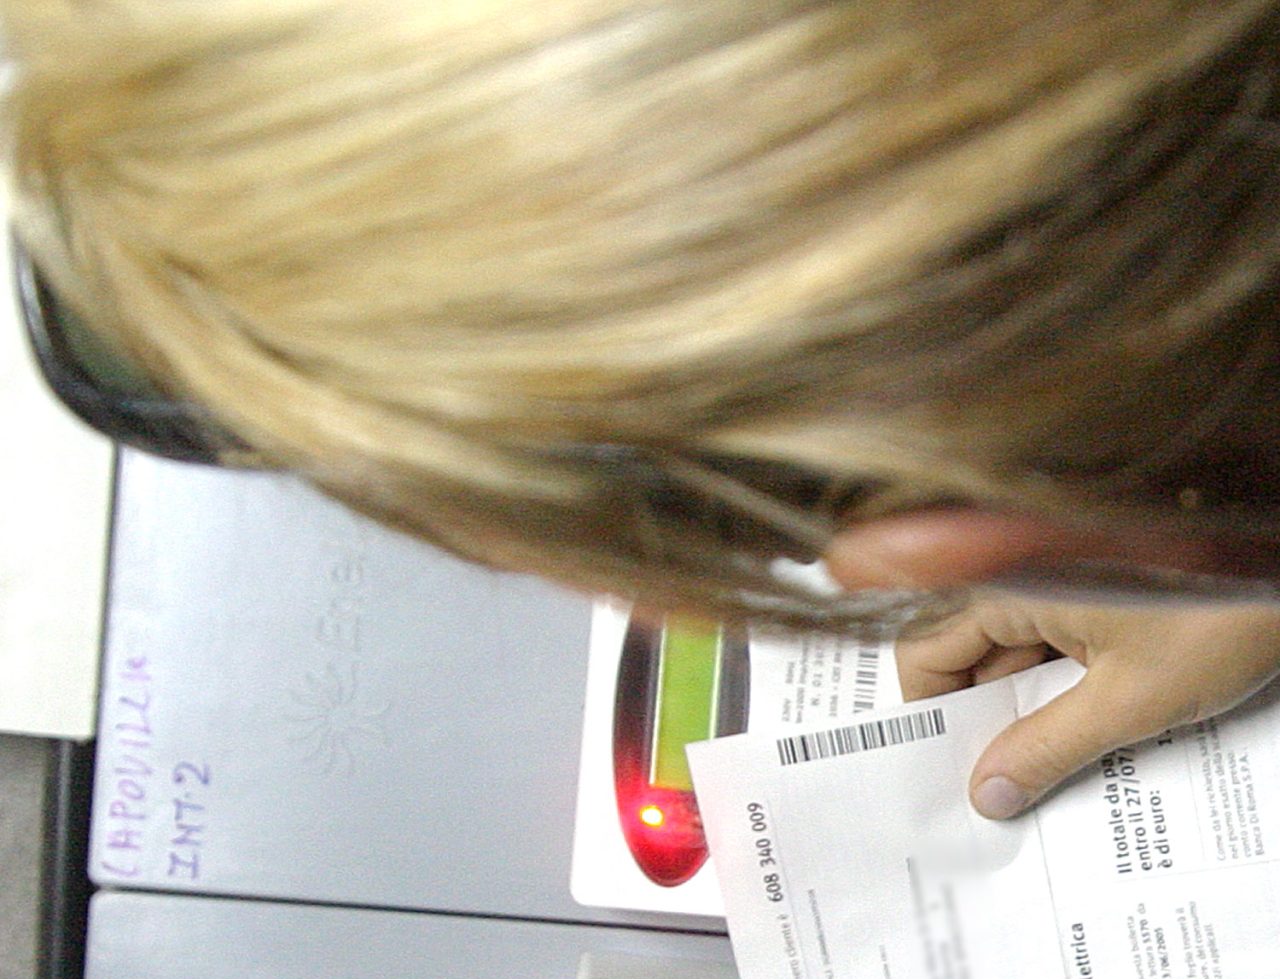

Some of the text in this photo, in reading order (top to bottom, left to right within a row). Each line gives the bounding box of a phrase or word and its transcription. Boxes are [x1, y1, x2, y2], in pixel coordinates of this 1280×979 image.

[1101, 783, 1120, 806] da
[746, 801, 768, 834] 009
[1106, 808, 1130, 859] totale
[1127, 811, 1144, 824] il
[1147, 789, 1173, 871] è di euro:
[754, 838, 776, 869] 340
[1131, 826, 1153, 873] entro
[1116, 862, 1132, 875] Il
[762, 872, 784, 904] 608
